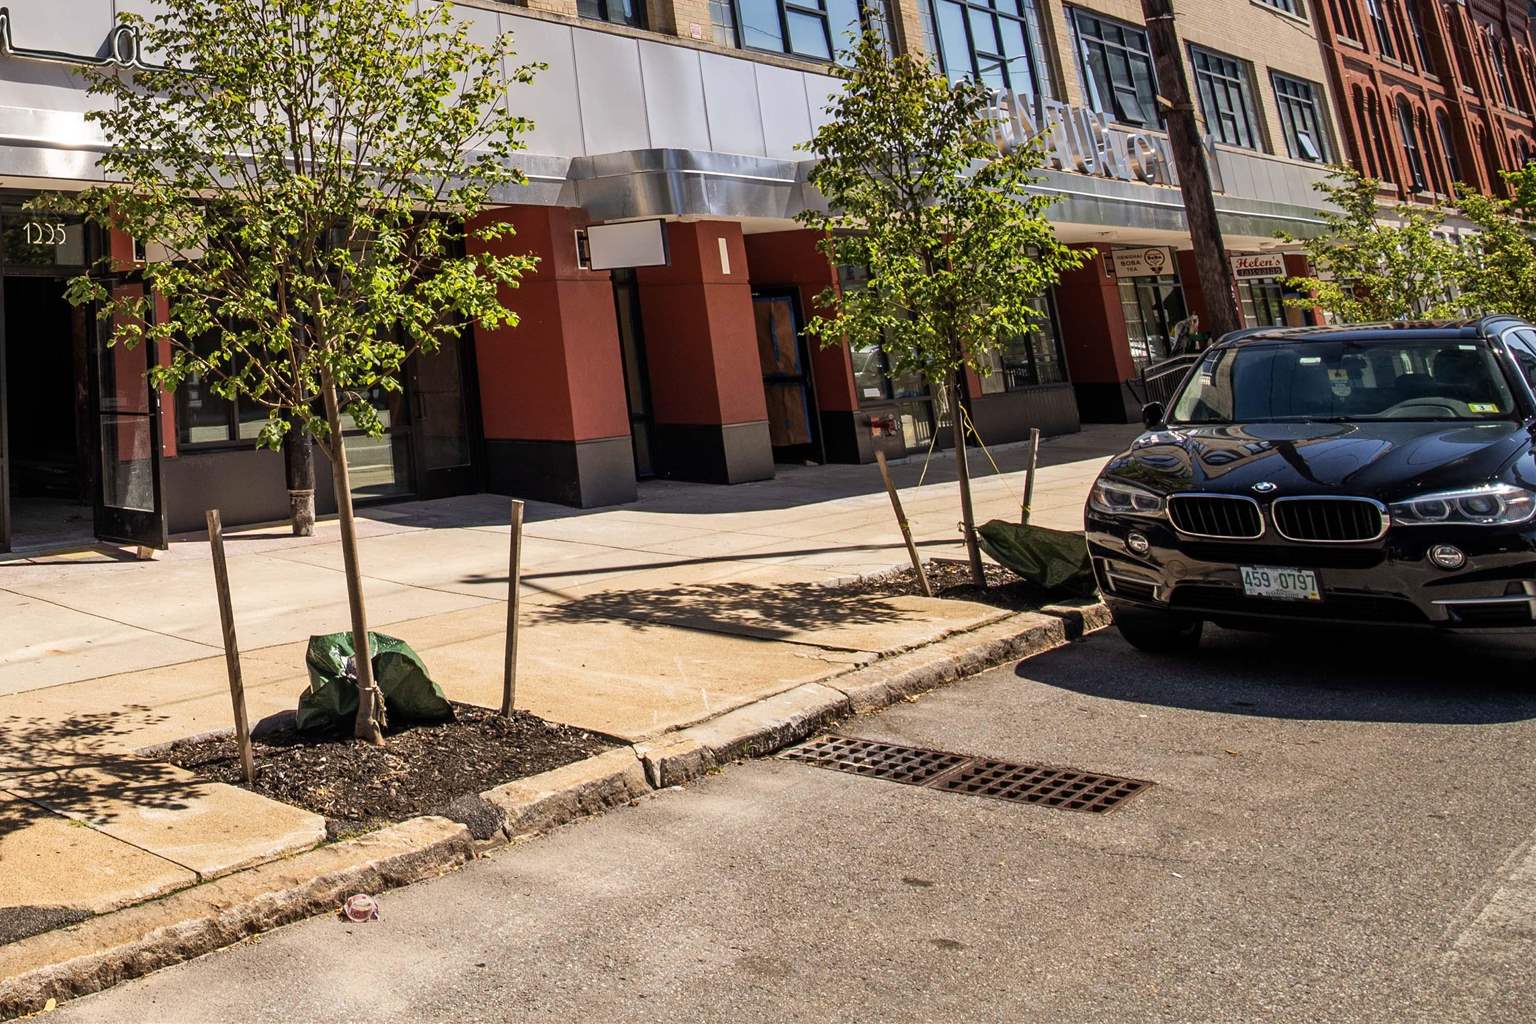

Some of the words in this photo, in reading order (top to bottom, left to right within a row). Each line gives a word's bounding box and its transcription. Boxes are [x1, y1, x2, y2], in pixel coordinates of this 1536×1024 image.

[22, 222, 66, 245] 1225
[1236, 256, 1281, 268] Helen's
[1245, 571, 1271, 587] 459
[1279, 573, 1315, 591] 0797
